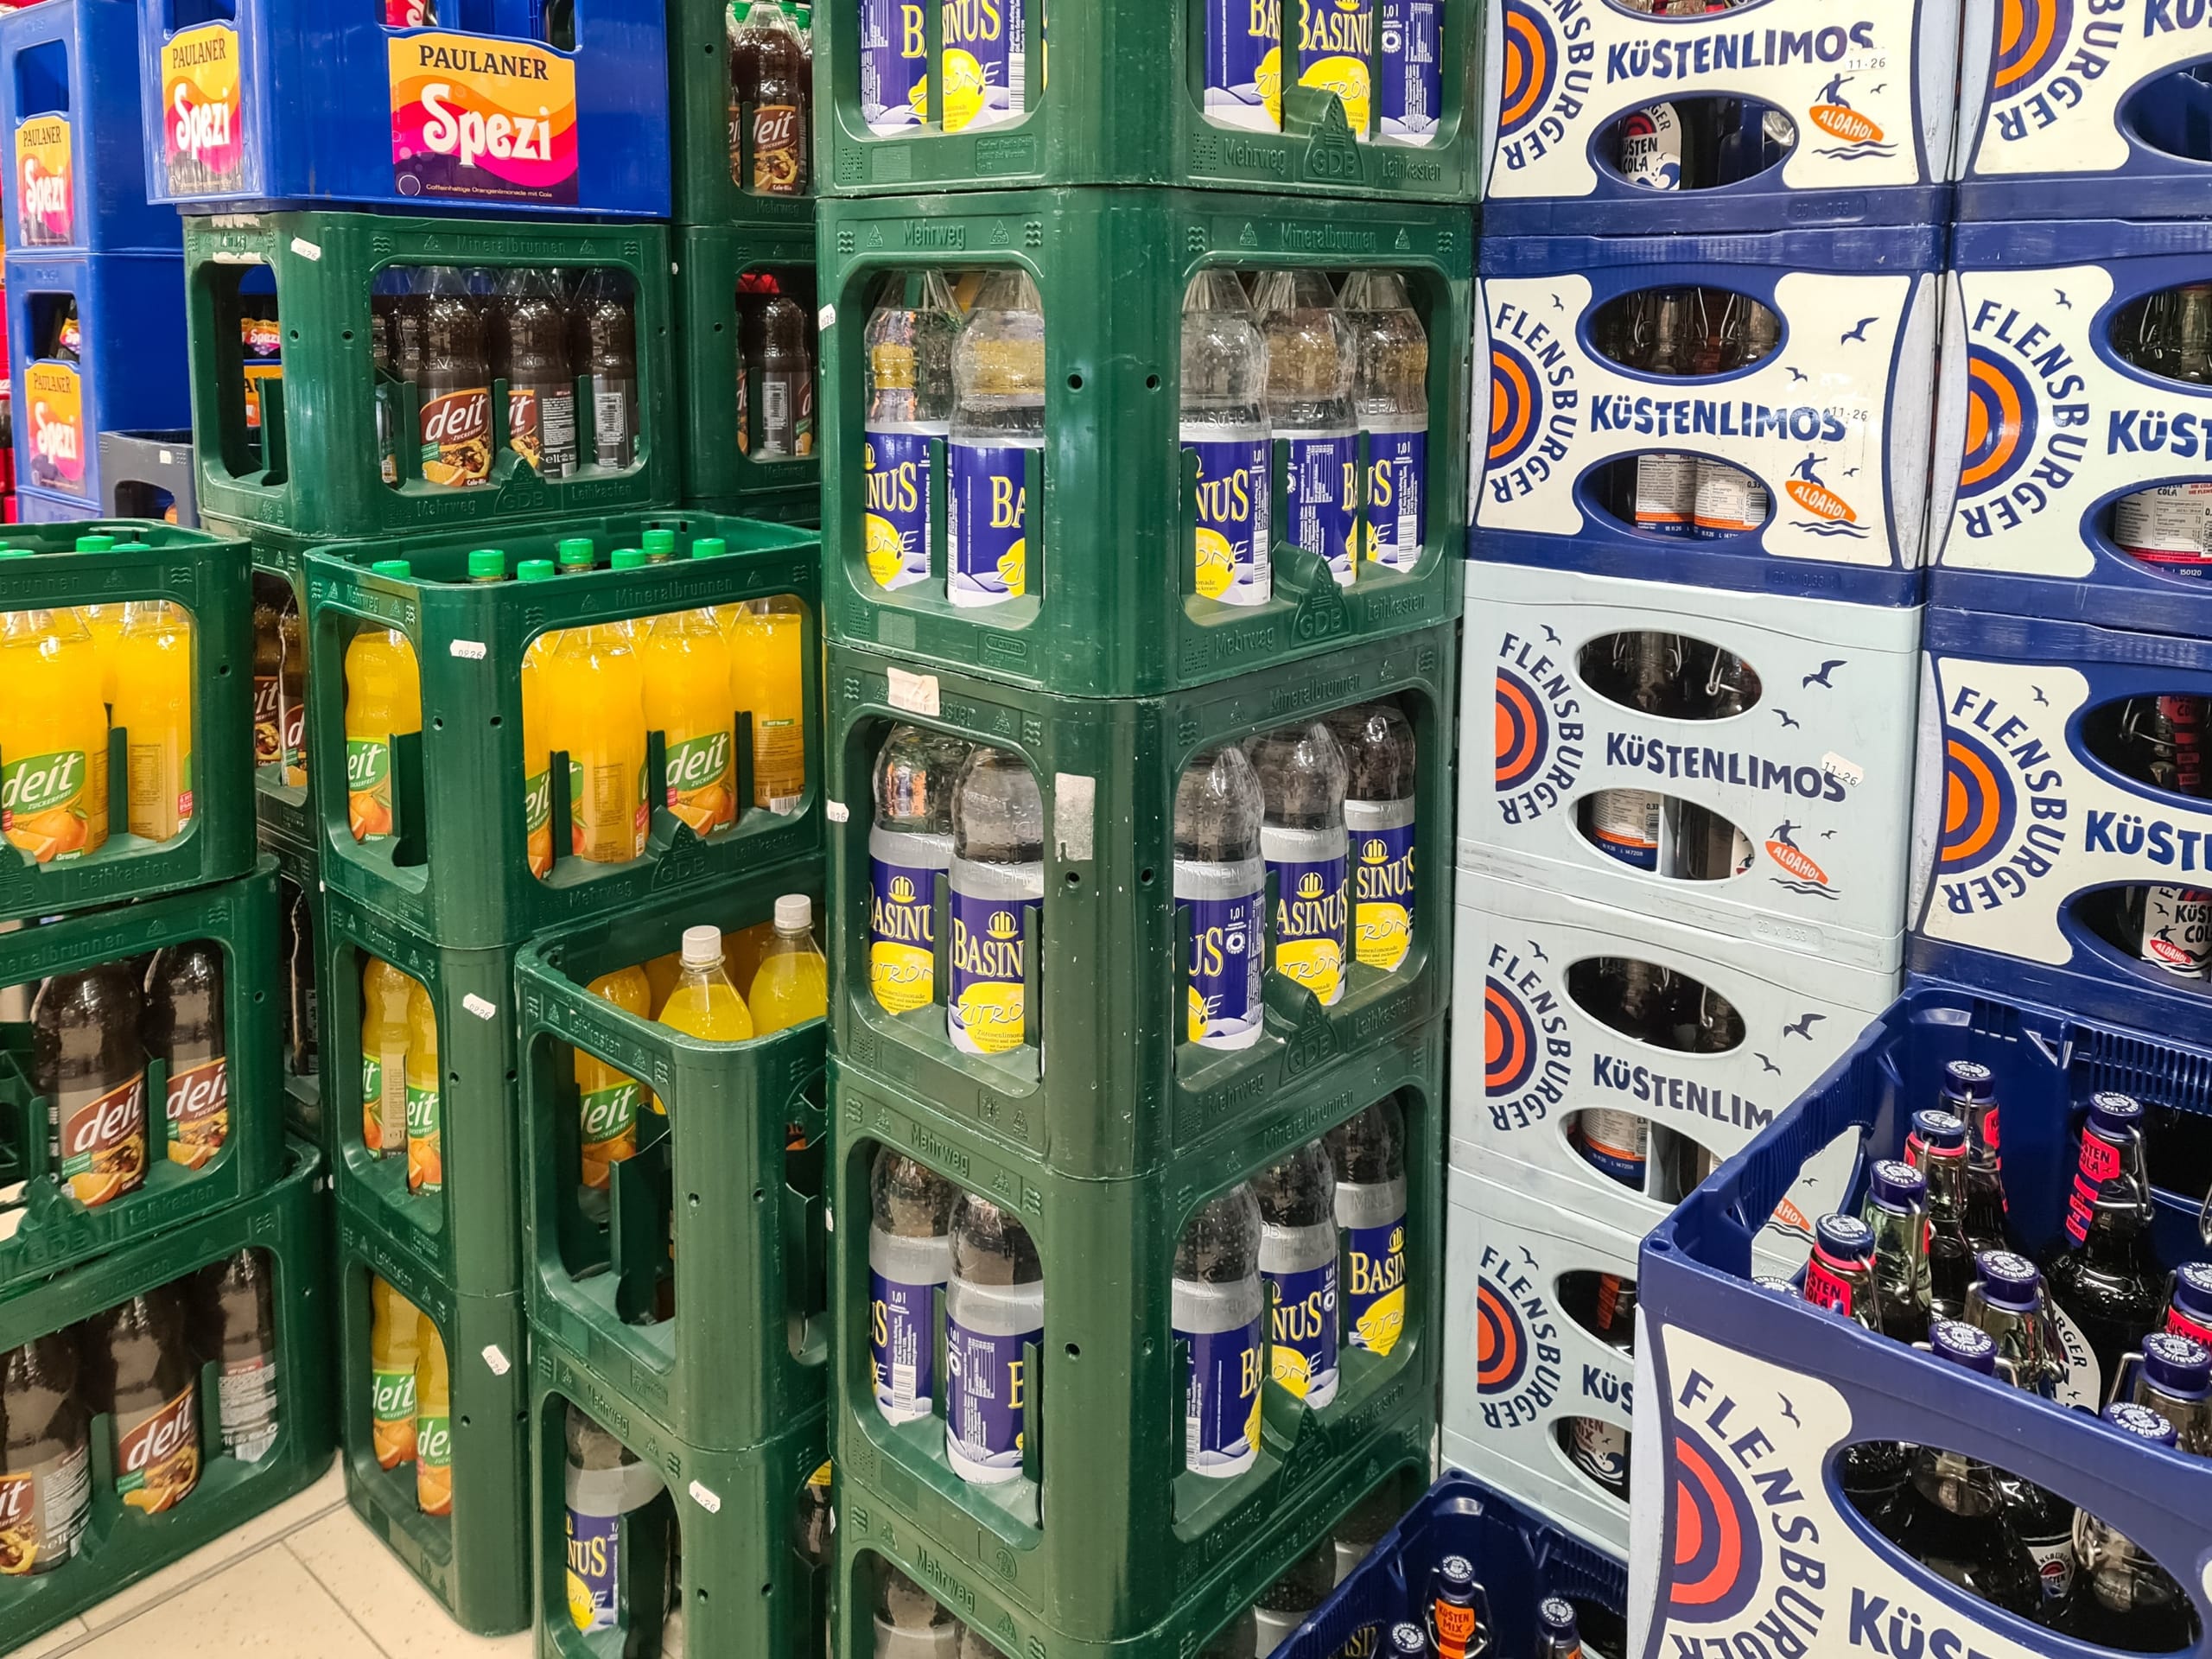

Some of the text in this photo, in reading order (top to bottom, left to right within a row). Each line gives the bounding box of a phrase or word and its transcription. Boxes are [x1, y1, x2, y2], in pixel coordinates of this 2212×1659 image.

[172, 38, 226, 69] PAULANER
[419, 44, 549, 80] PAULANER
[1607, 22, 1874, 84] KÜSTENLIMOS
[1502, 0, 1595, 170] NSBURGER
[23, 126, 62, 148] PAULANER
[175, 83, 231, 160] Spezi
[420, 83, 552, 168] Spezi
[1818, 110, 1873, 139] ALOAHOI
[1224, 138, 1286, 174] Mehrweg
[24, 157, 66, 221] Spezi
[426, 183, 470, 193] Coffeinhaltige
[472, 186, 526, 197] Orangenlimonade
[903, 220, 966, 249] Mehrweg
[34, 373, 71, 393] PAULANER
[1490, 303, 1578, 504] FLENSBURGER
[35, 402, 77, 463] Spezi
[426, 393, 487, 442] deit
[1591, 394, 1847, 442] KÜSTENLIMOS
[1959, 299, 2089, 539] FLENSBURGER
[416, 499, 476, 518] Mehrweg
[571, 484, 632, 501] Leihkasten
[1794, 485, 1847, 518] ALOAHOI
[615, 576, 733, 607] Mineralbrunnen
[1215, 592, 1426, 658] Mehrweg GDB Leihkasten
[1497, 632, 1584, 824] FLENSBURGER
[1, 753, 84, 807] deit
[666, 732, 729, 785] deit
[1607, 731, 1847, 803] KÜSTENLIMOS
[1942, 686, 2068, 914] FLENSBURGER
[78, 860, 171, 890] Leihkasten
[1773, 845, 1820, 880] ALOAHOI
[2155, 943, 2188, 963] ALOAHOI
[1487, 943, 1573, 1131] FLENSBURGER
[74, 1078, 143, 1153] deit
[911, 1124, 969, 1178] Mehrweg
[1478, 1244, 1561, 1429] FLENSBURGER
[127, 1394, 194, 1470] deit
[917, 1545, 976, 1615] Mehrweg
[1438, 1605, 1469, 1624] KÜSTEN
[1443, 1618, 1463, 1633] MIX
